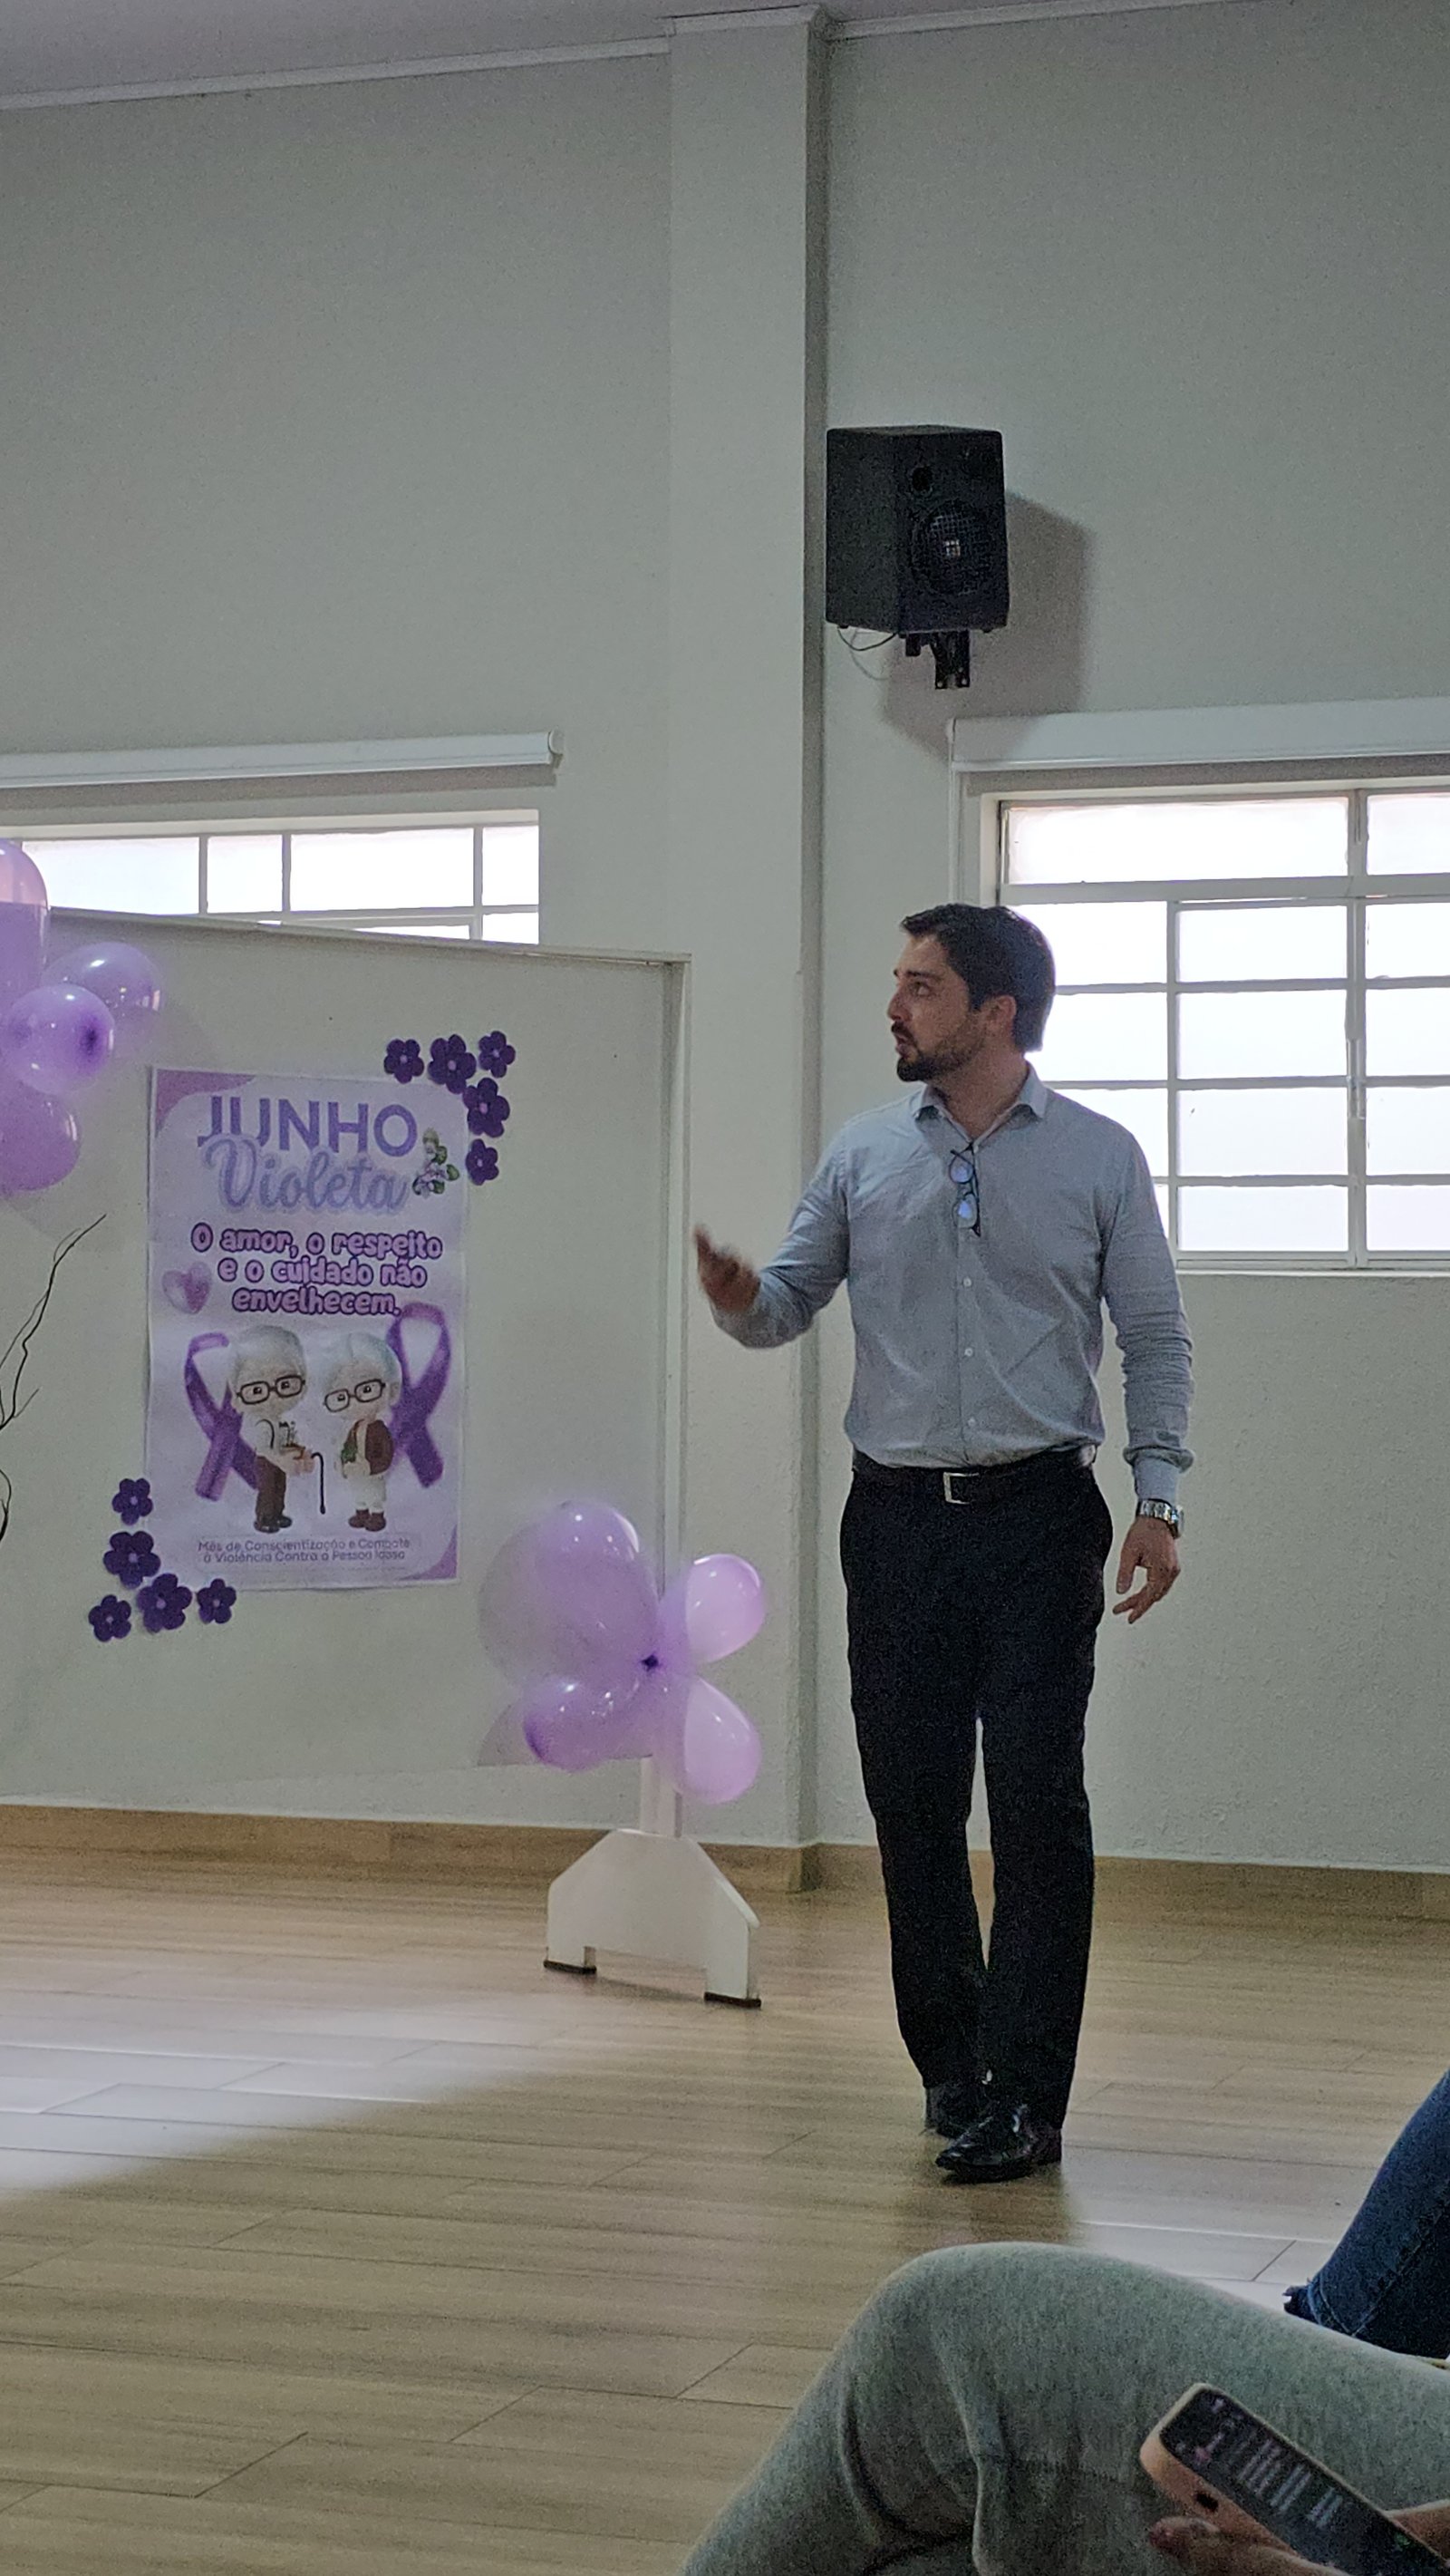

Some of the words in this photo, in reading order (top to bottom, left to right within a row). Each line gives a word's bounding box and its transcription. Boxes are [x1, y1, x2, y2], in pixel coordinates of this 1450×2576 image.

[198, 1096, 418, 1157] JUNHO
[203, 1138, 409, 1209] Violeta
[190, 1222, 214, 1253] O
[219, 1228, 299, 1258] amor,
[306, 1232, 325, 1255] o
[331, 1230, 443, 1260] respeito
[218, 1257, 238, 1283] e
[245, 1260, 265, 1283] o
[271, 1256, 374, 1286] cuidado
[379, 1257, 428, 1288] não
[231, 1286, 402, 1316] envelhecem.
[226, 1541, 241, 1553] de
[275, 1550, 317, 1563] Contra
